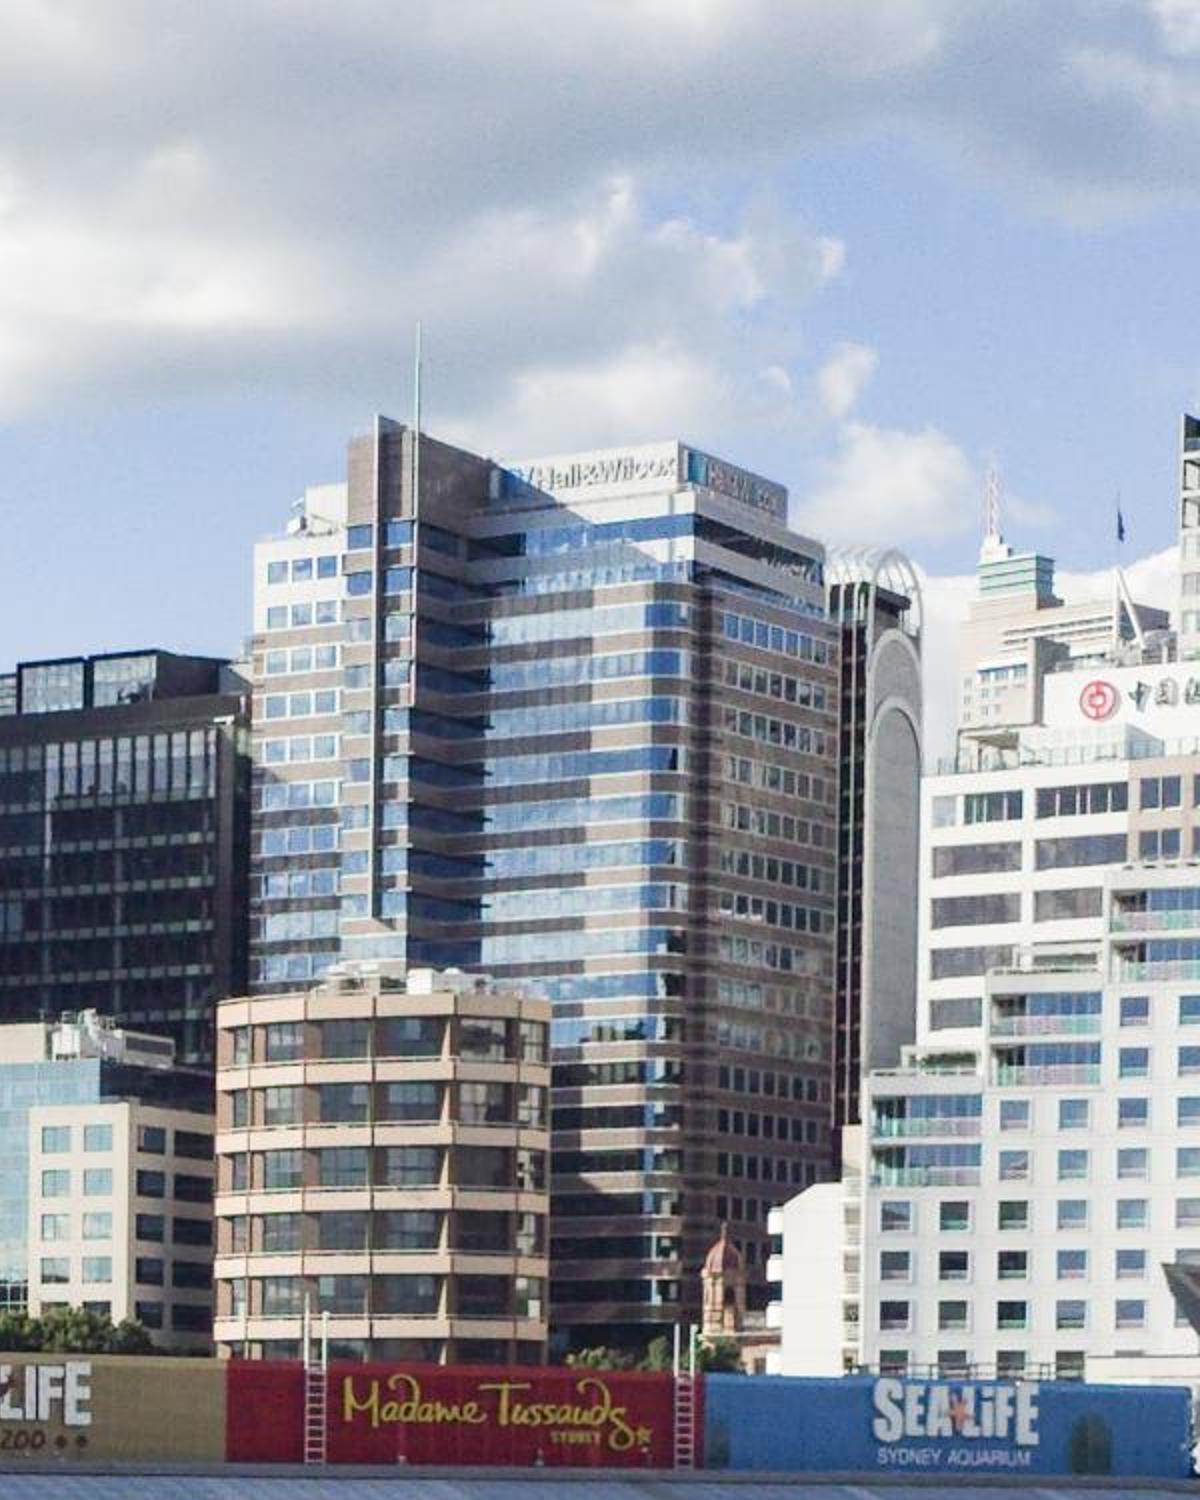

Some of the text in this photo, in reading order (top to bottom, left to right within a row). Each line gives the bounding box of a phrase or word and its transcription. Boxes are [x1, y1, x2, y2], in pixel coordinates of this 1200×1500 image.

[0, 1361, 92, 1425] LIFE
[344, 1374, 637, 1450] Madame Tussauds
[873, 1377, 954, 1443] SEA
[0, 1429, 47, 1450] ZOO
[877, 1447, 1032, 1467] SYDNEY AQUARIUM
